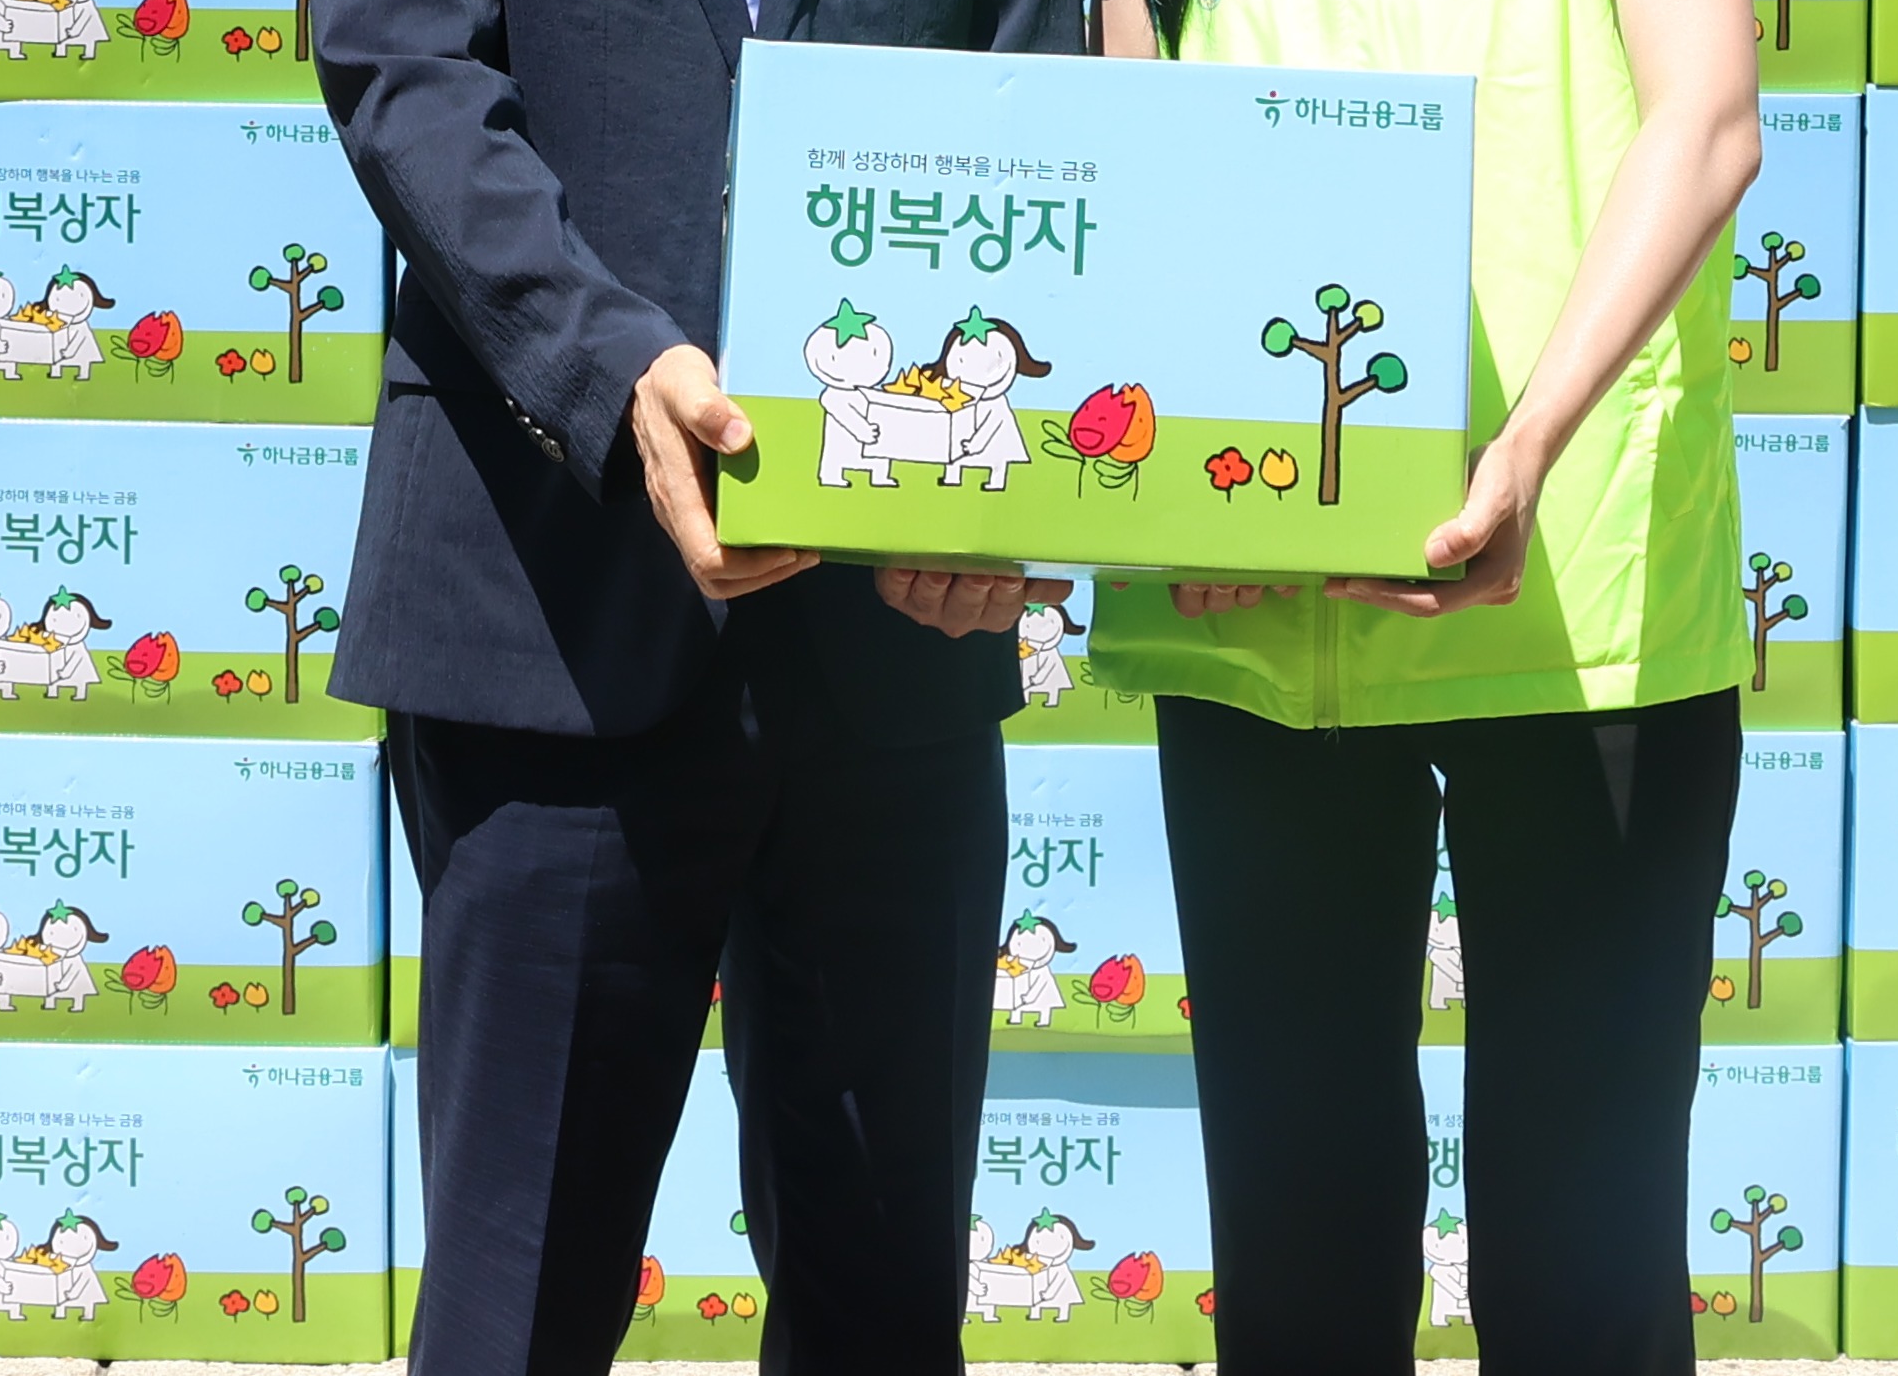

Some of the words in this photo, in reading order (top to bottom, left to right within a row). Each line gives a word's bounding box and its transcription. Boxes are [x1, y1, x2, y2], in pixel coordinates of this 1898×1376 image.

[1295, 97, 1444, 131] 하나금융그룹
[806, 147, 846, 171] 함께
[852, 149, 929, 175] 성장하며
[934, 152, 992, 178] 행복을
[997, 156, 1055, 181] 나누는
[1061, 159, 1099, 183] 금융
[805, 182, 1097, 275] 행복상자
[259, 760, 356, 781] 하나금융그룹
[30, 803, 68, 818] 행복을
[70, 804, 108, 819] 나누는
[110, 805, 135, 820] 금융
[1726, 1065, 1823, 1085] 하나금융그룹
